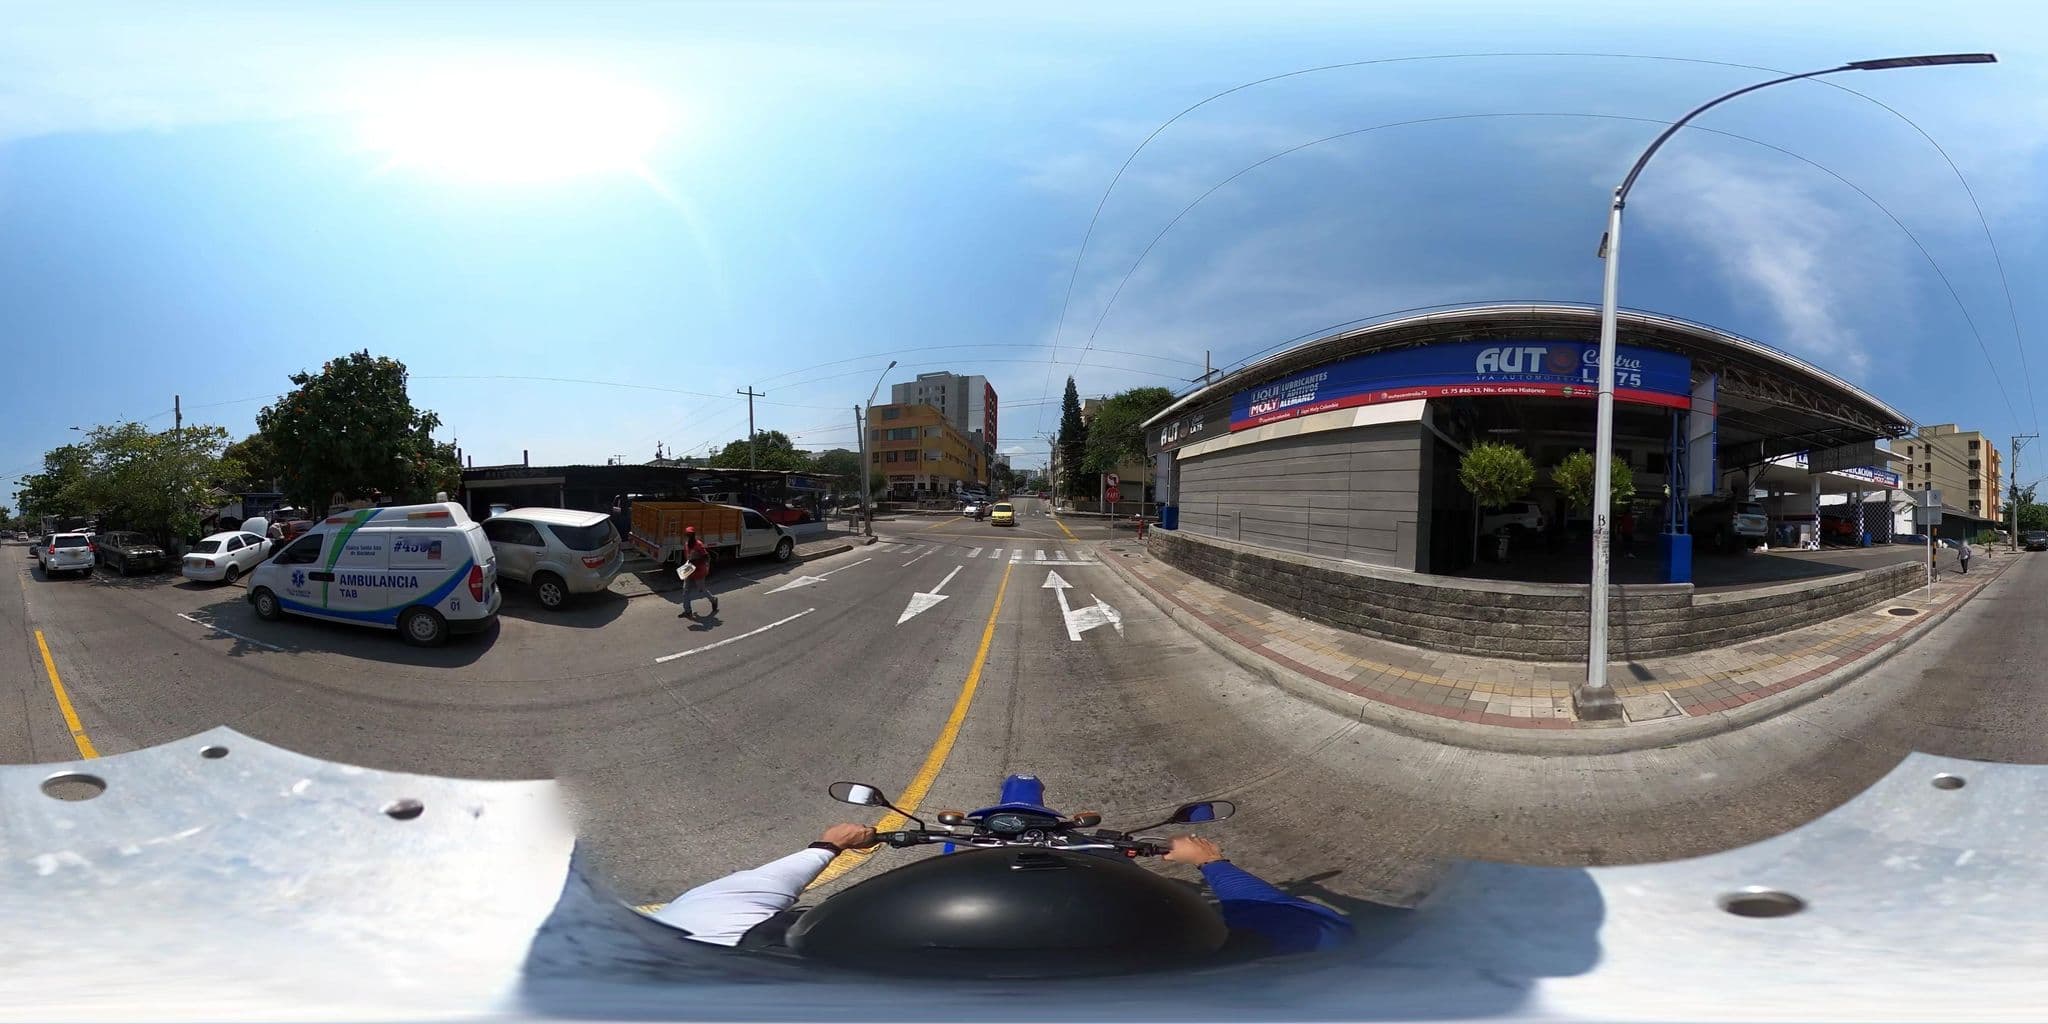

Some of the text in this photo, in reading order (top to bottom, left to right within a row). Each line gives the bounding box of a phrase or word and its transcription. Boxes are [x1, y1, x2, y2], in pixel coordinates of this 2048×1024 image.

[1281, 371, 1329, 392] LUBRICANTES
[1616, 372, 1642, 387] 75
[1286, 382, 1320, 398] ADITIVOS
[1250, 398, 1280, 416] MOLY
[339, 574, 418, 588] AMBULANCIA
[339, 588, 358, 598] TAB
[450, 601, 460, 611] 01
